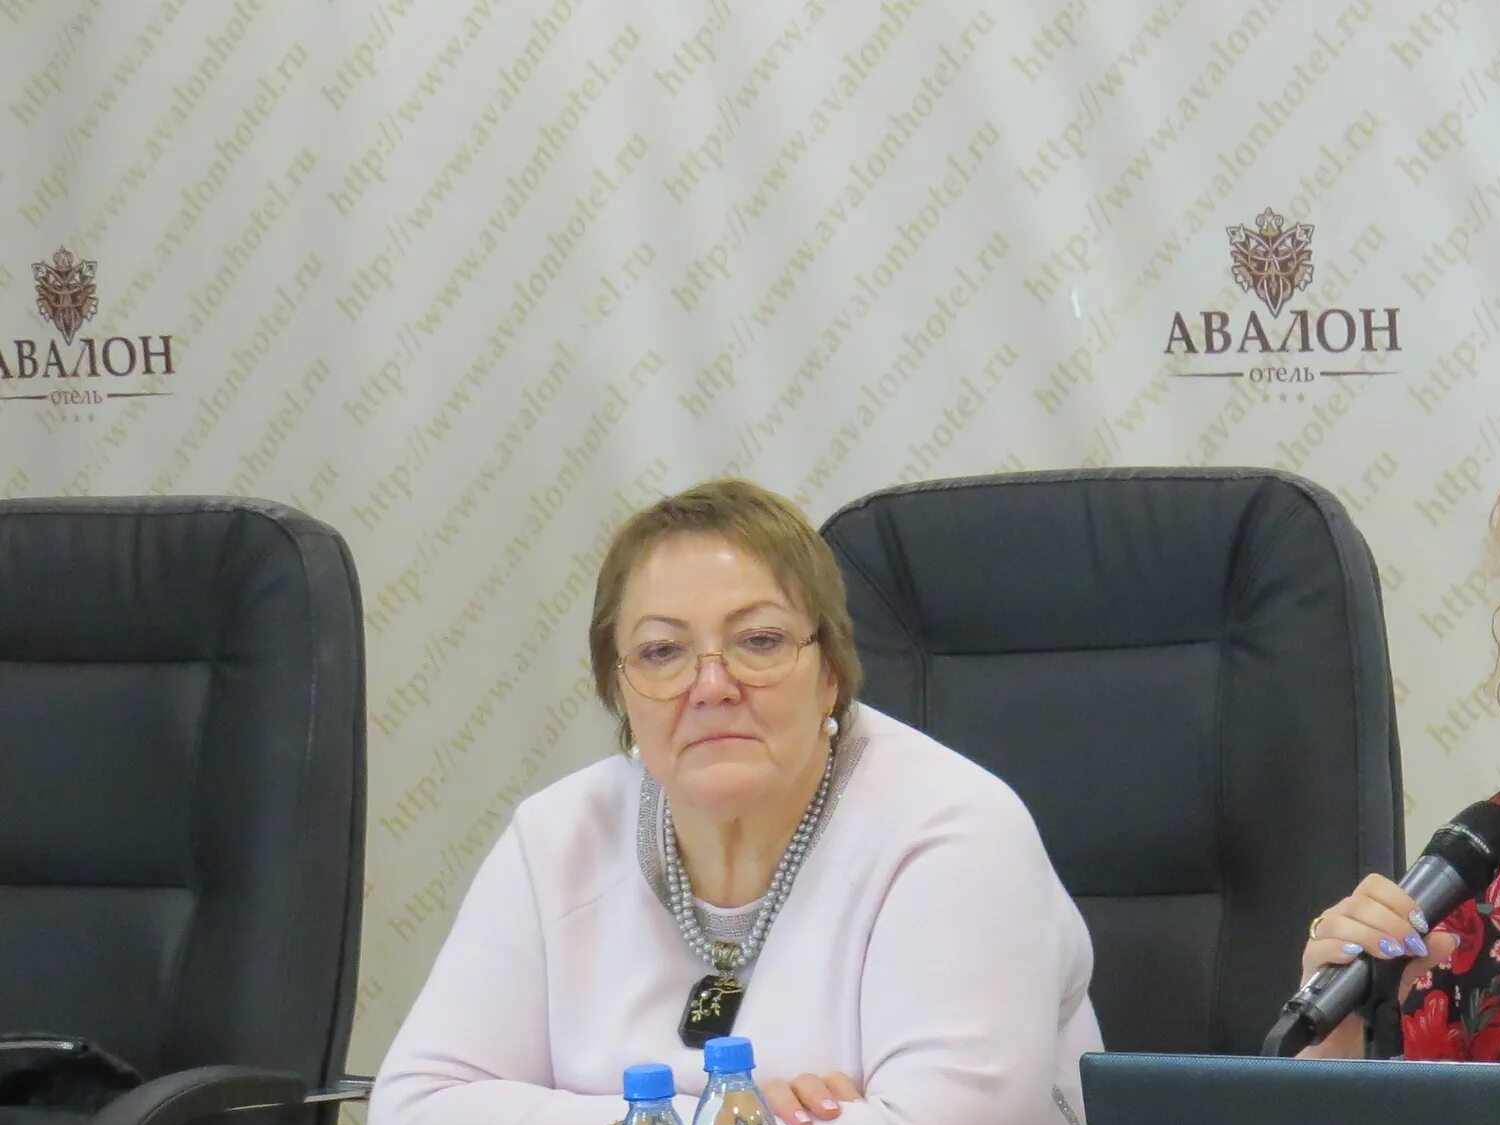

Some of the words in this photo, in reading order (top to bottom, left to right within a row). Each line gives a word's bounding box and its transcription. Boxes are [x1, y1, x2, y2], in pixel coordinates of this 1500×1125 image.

[338, 22, 640, 430] http://www.avalonhotel.ru
[675, 8, 994, 418] http://www.avalonhotel.ru
[1163, 308, 1403, 354] АВАЛОН
[1249, 366, 1315, 383] отель
